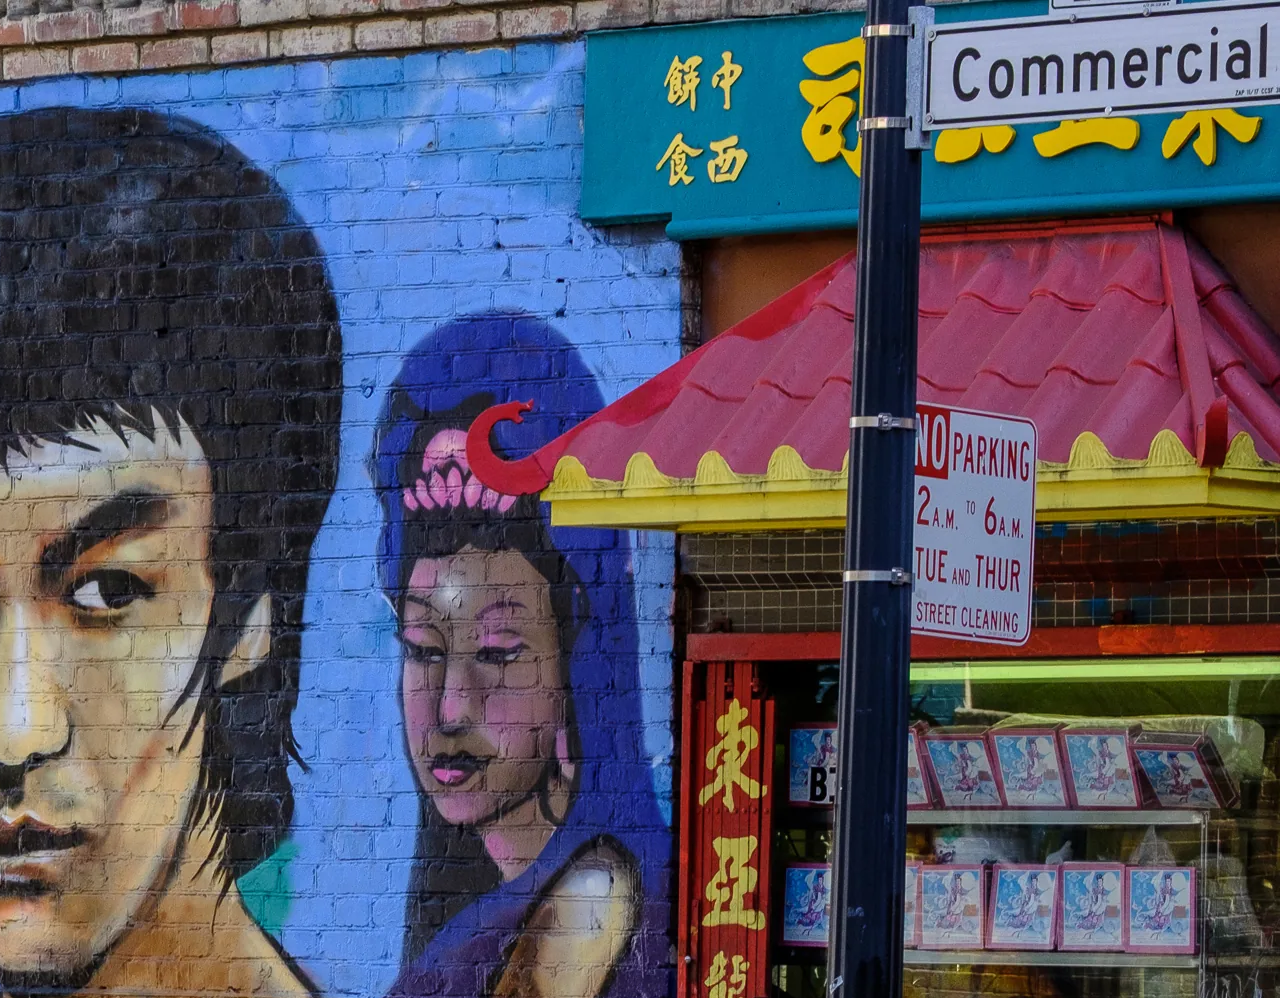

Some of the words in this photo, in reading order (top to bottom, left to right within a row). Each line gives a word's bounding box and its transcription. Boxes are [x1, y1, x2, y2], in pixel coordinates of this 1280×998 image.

[951, 22, 1269, 102] Commercial
[915, 411, 947, 471] NO
[952, 431, 1030, 482] PARKING
[966, 500, 976, 515] TO
[915, 546, 948, 583] TUE
[952, 568, 970, 586] AND
[975, 554, 1021, 593] THUR
[916, 600, 958, 626] STREET
[960, 606, 1019, 634] CLEANING
